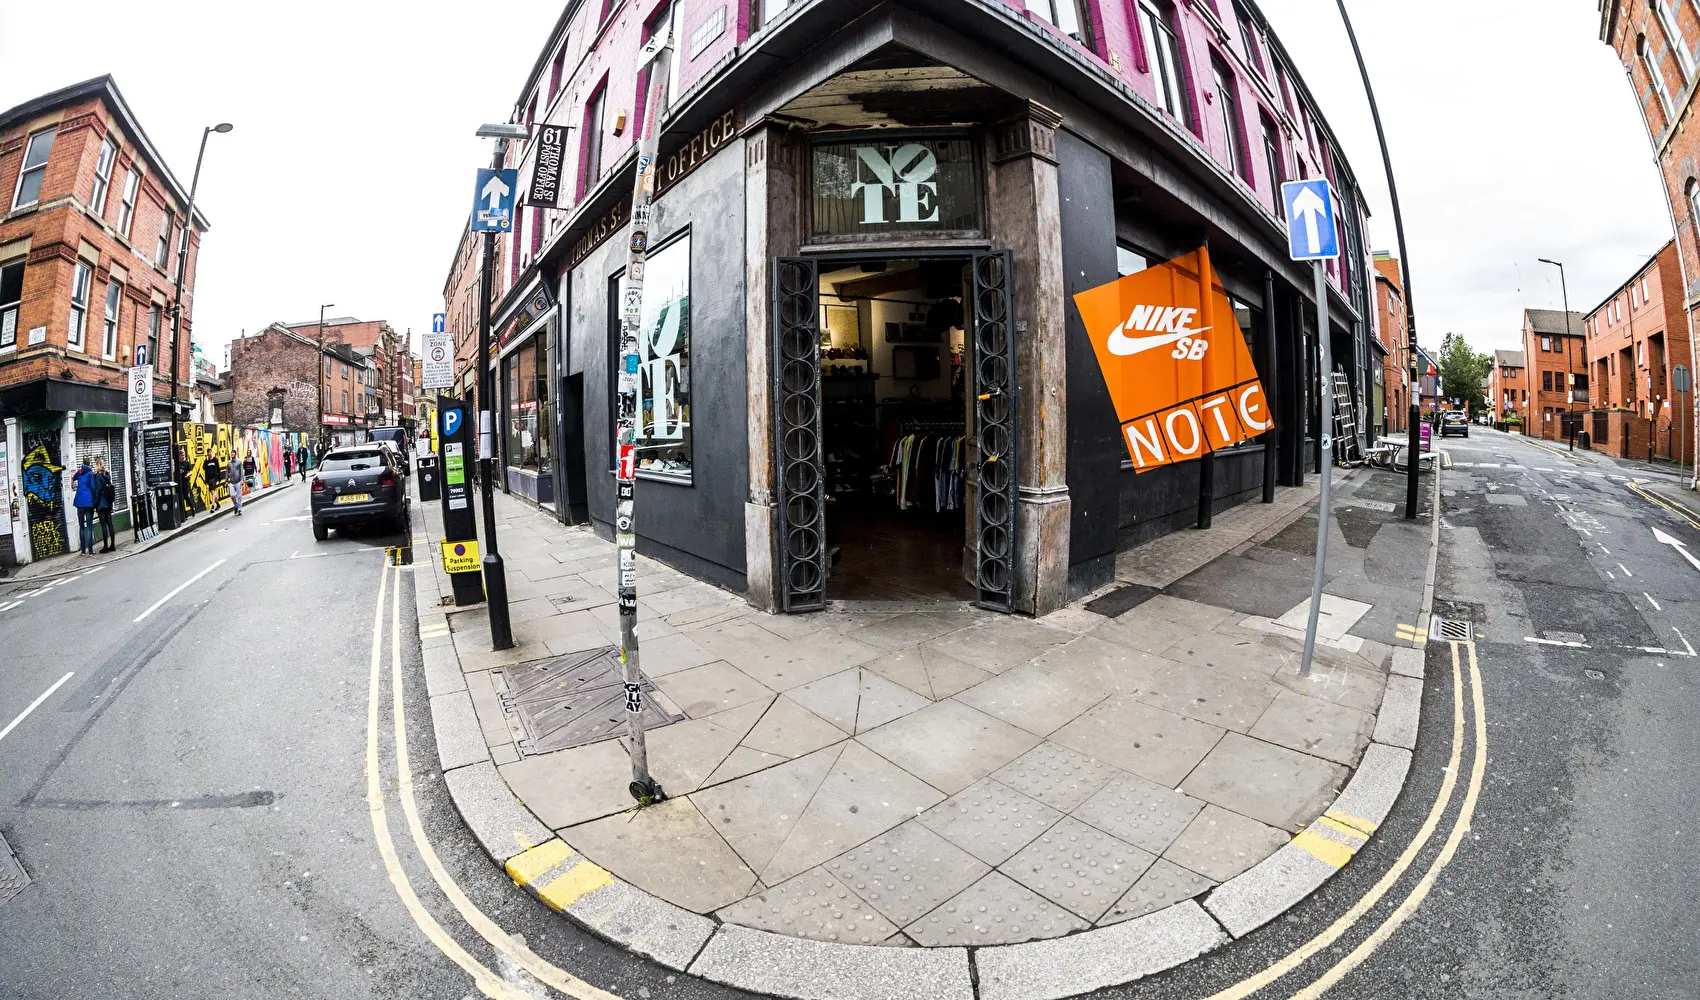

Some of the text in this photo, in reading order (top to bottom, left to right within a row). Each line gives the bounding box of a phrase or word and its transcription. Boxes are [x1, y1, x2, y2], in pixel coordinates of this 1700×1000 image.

[543, 127, 562, 146] 61
[668, 109, 734, 180] OFFICE
[533, 144, 551, 200] POST OFFICE
[545, 145, 561, 188] THOMAS
[851, 143, 937, 183] NO
[851, 181, 939, 224] TE
[571, 217, 607, 265] THOMAS
[1124, 304, 1198, 333] NIKE
[1171, 337, 1209, 361] SB
[445, 411, 457, 431] P
[1125, 385, 1272, 468] NOTE
[447, 564, 480, 572] Suspension
